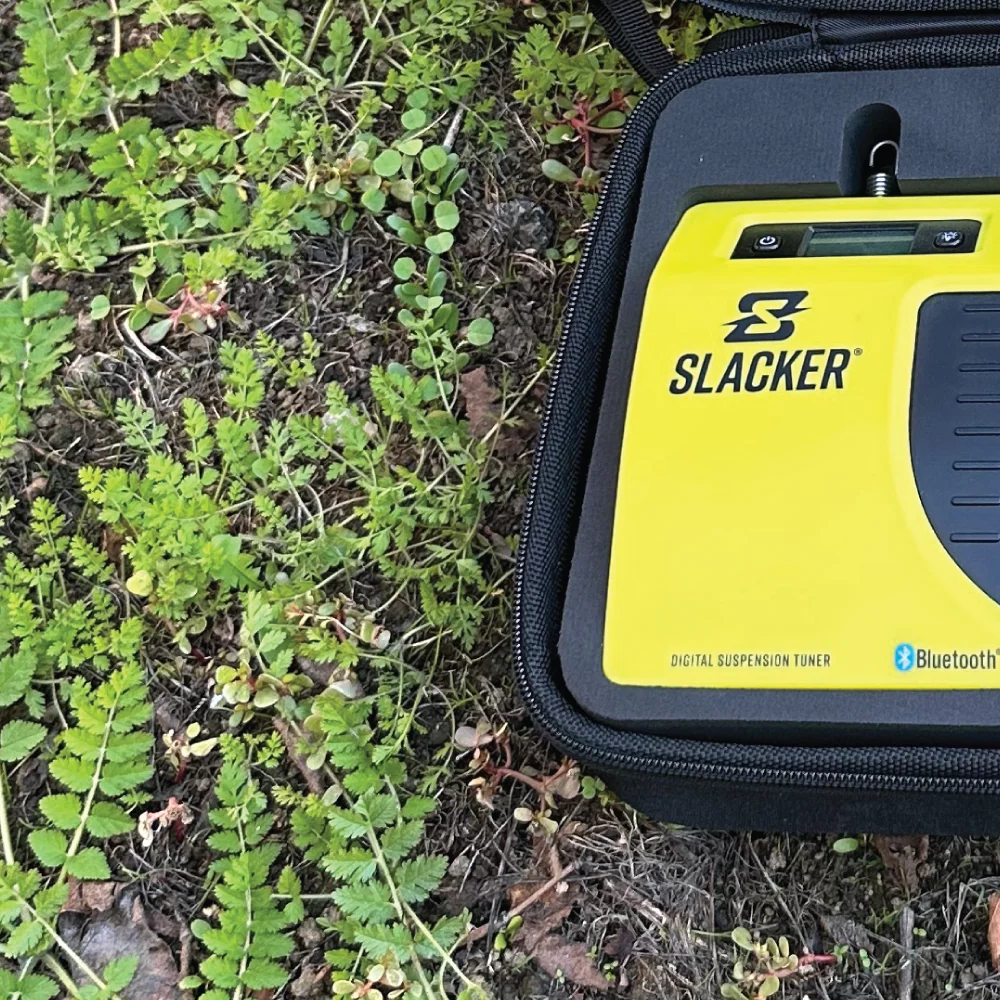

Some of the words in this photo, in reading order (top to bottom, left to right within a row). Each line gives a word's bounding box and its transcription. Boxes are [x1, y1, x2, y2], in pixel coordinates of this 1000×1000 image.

[670, 654, 714, 668] DIGITAL
[717, 654, 790, 667] SUSPENSION
[794, 654, 831, 667] TUNER
